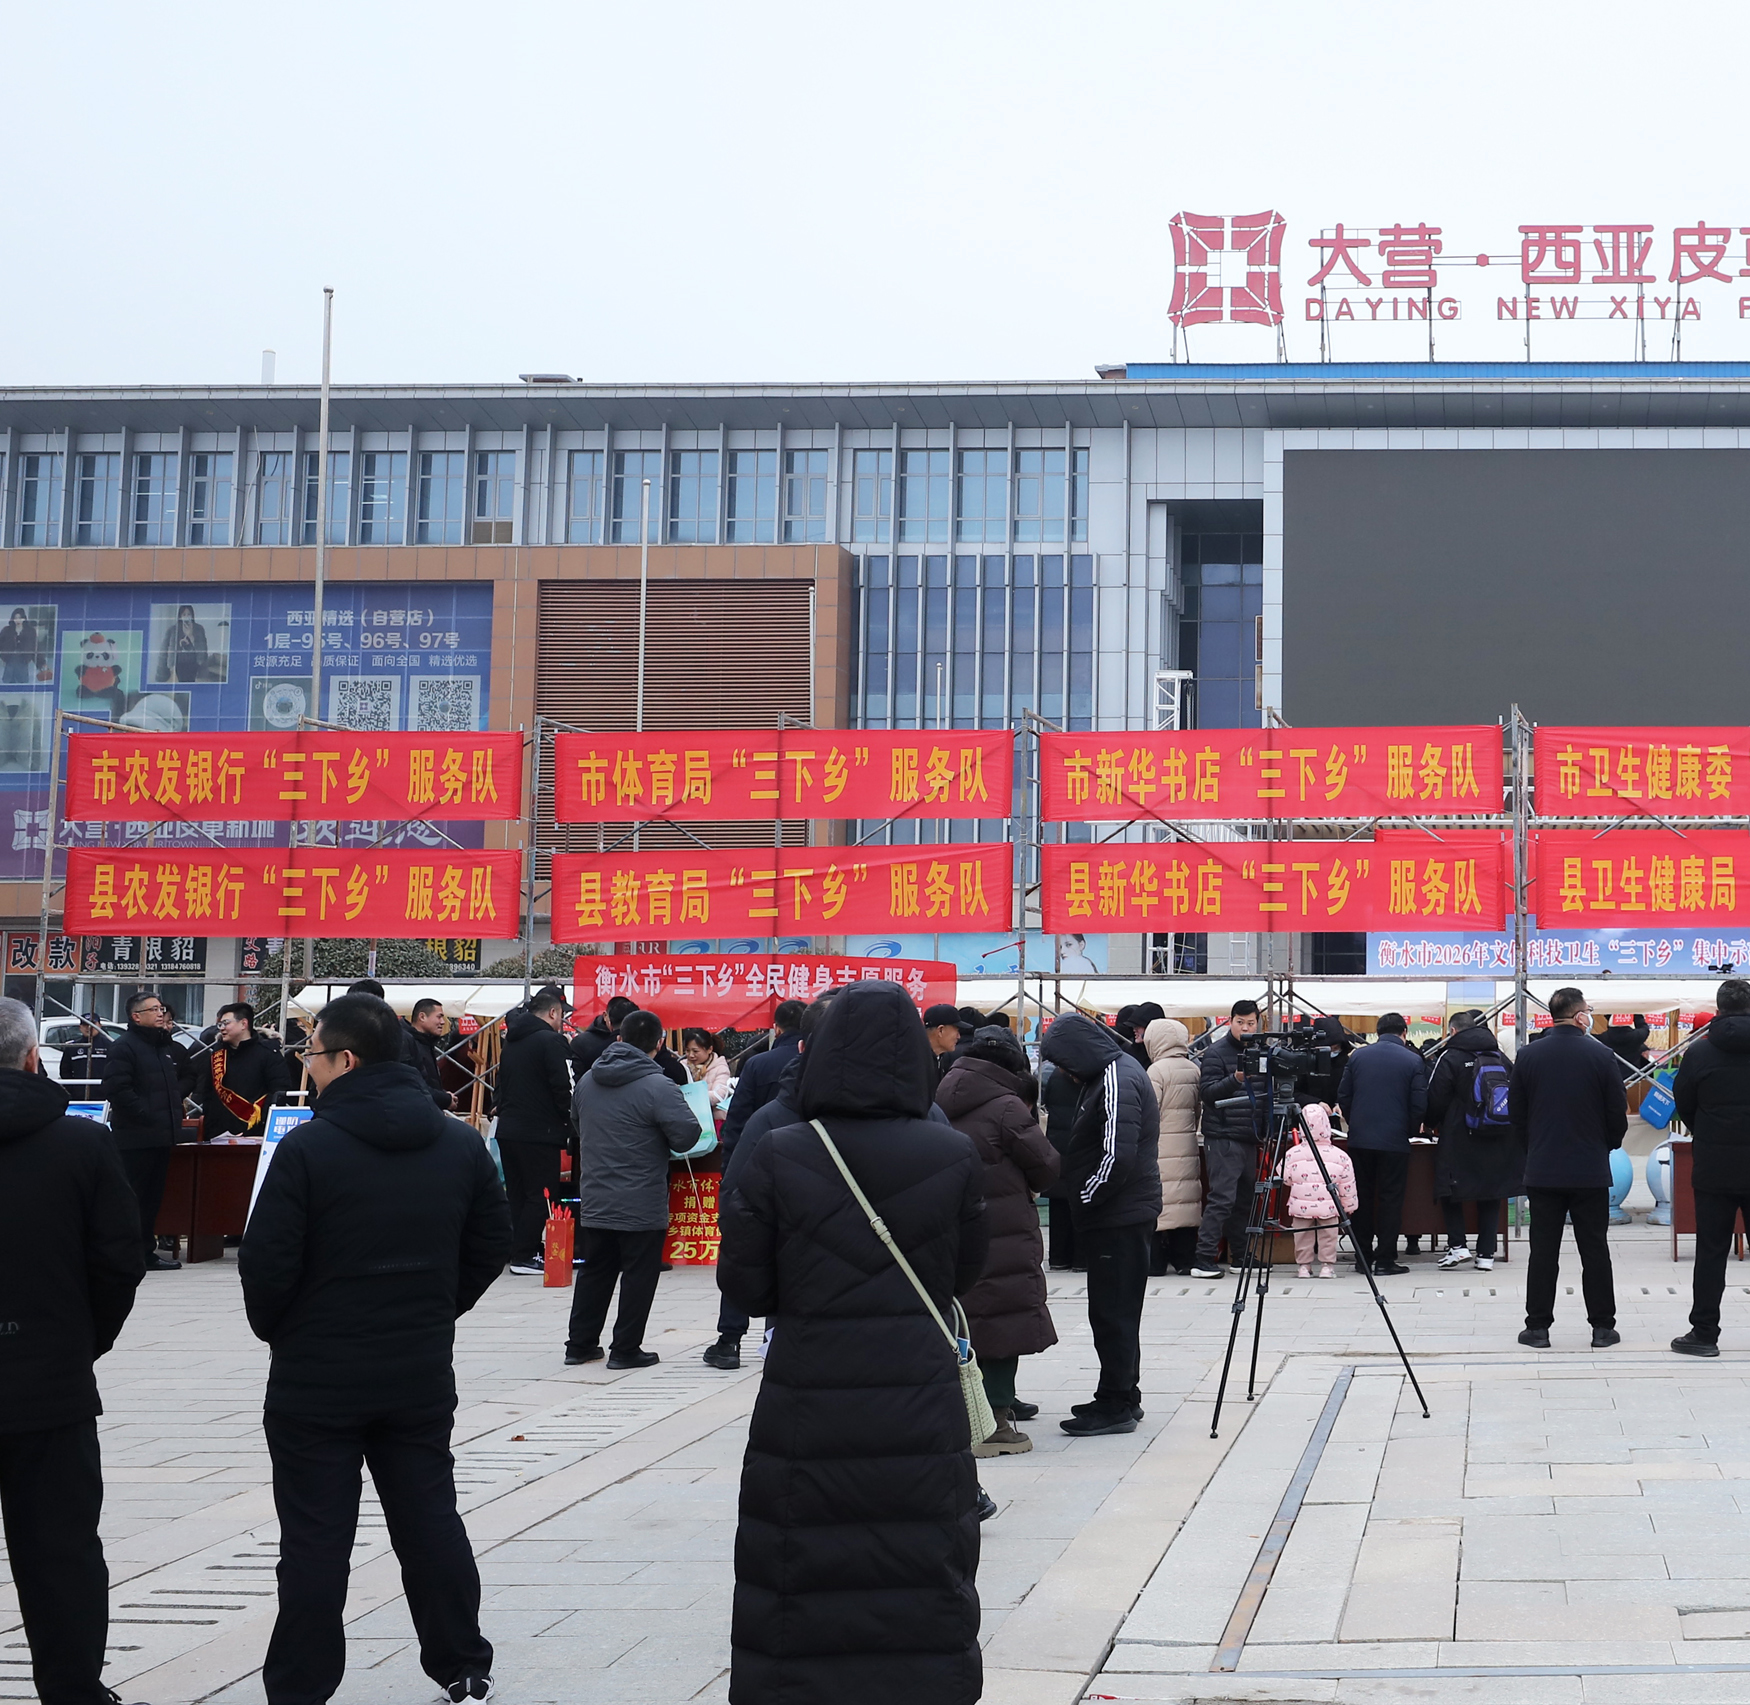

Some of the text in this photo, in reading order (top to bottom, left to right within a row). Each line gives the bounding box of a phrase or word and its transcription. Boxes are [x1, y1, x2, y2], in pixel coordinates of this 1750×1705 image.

[1305, 297, 1459, 321] DAYING
[1497, 296, 1579, 320] NEW
[1609, 295, 1702, 320] XIYA
[253, 654, 478, 668] 货源充足 质保证 面向全国 精选优选
[92, 748, 498, 806] 市农发银行“三下乡”服务队
[578, 746, 989, 806] 市体育局“三下乡”服务队
[1064, 742, 1480, 805] 市新华书店“三下乡”服务队
[89, 863, 497, 922] 县农发银行“三下乡”服务队
[575, 860, 990, 927] 县教育局“三下乡”服务队
[1065, 858, 1483, 918] 县新华书店“三下乡”服务队
[11, 936, 77, 970] 改款
[669, 1240, 721, 1262] 25万
